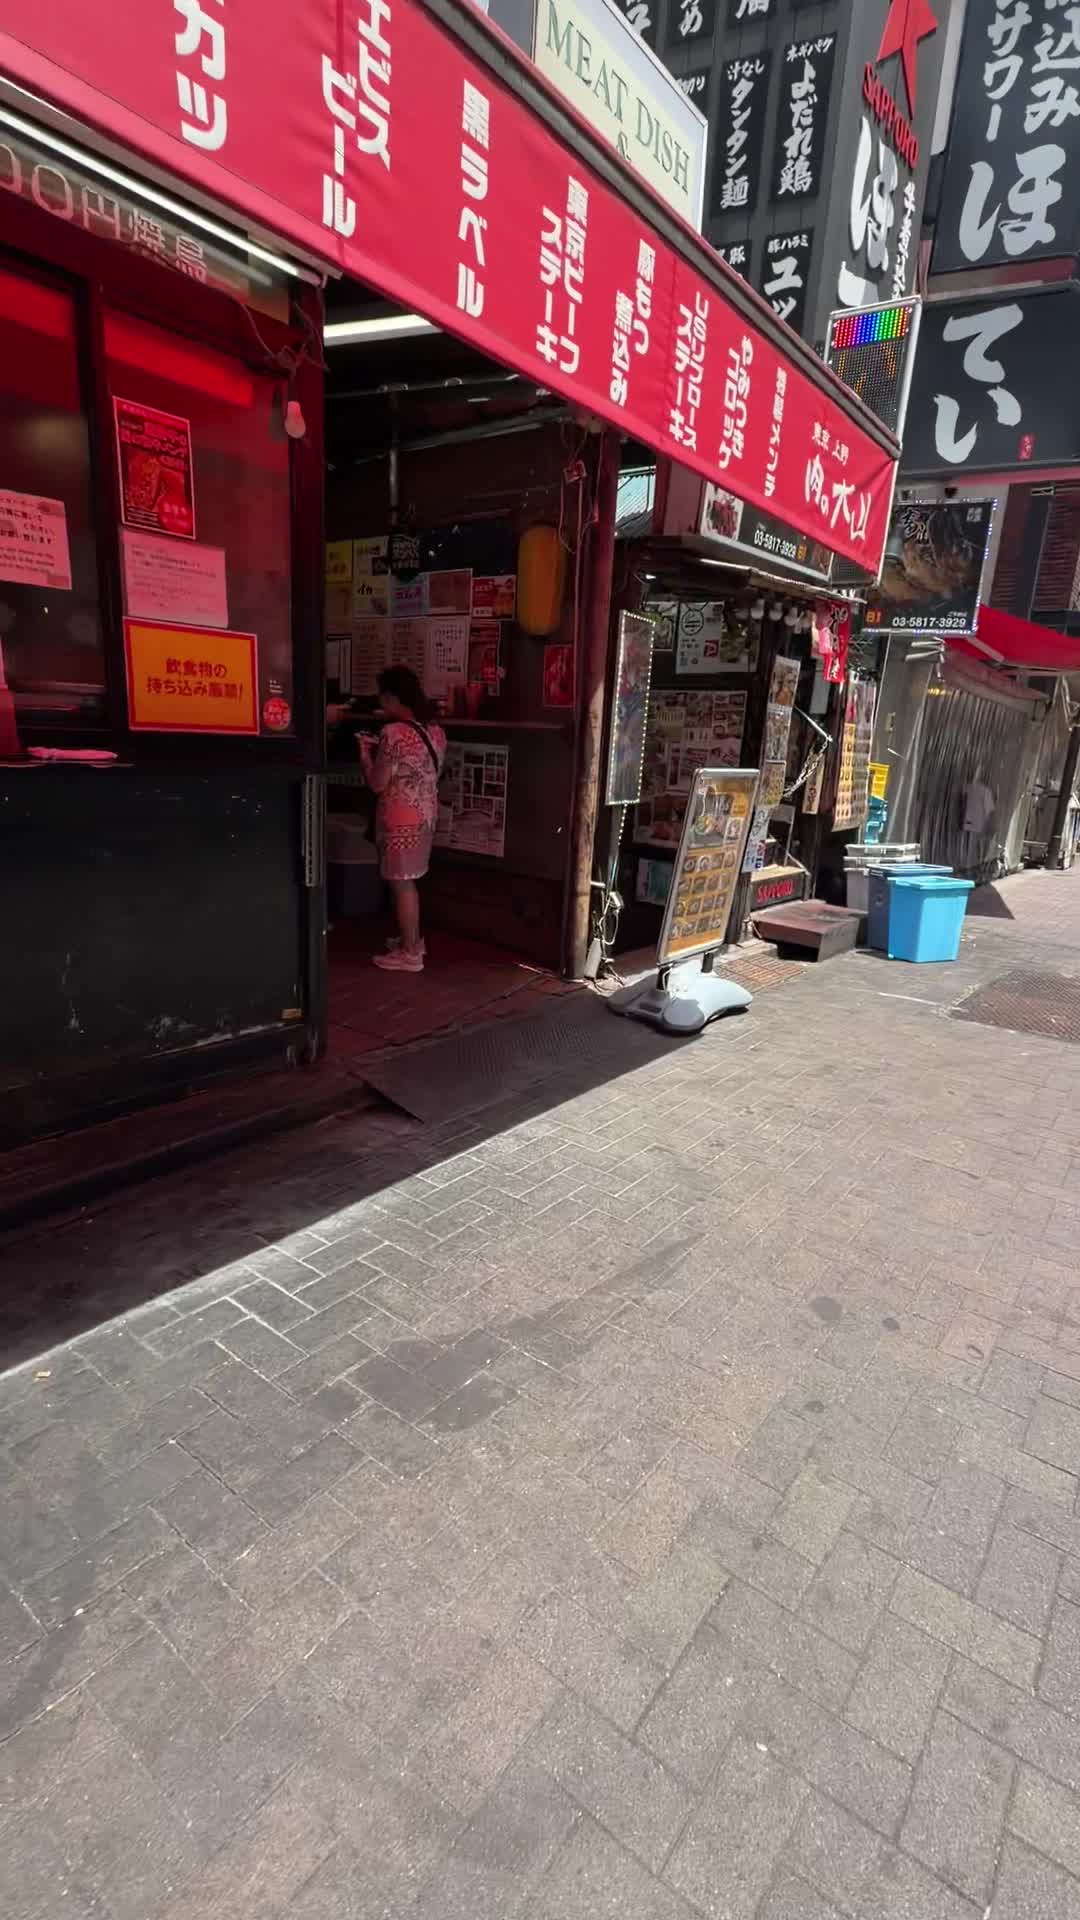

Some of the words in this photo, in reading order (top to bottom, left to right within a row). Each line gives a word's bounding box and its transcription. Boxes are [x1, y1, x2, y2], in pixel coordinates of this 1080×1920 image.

[546, 0, 628, 124] MEAT
[635, 97, 690, 195] DISH
[727, 58, 765, 81] 汁なし
[777, 58, 818, 195] よだれ鶏
[863, 62, 919, 169] SAPPORO
[984, 0, 1033, 142] サワー
[321, 53, 356, 238] ビール
[457, 79, 490, 318] 黒ラベル
[720, 77, 754, 209] タンタン麺
[536, 205, 563, 363] ステーキ
[559, 175, 588, 374] 東京ビーフ
[633, 238, 656, 355] 豚もつ
[610, 290, 634, 407] 煮込み
[669, 304, 693, 441] ステーキ
[719, 348, 741, 470] コロッケ
[165, 658, 228, 679] 飲食物の
[892, 616, 967, 628] 03-5817-3929
